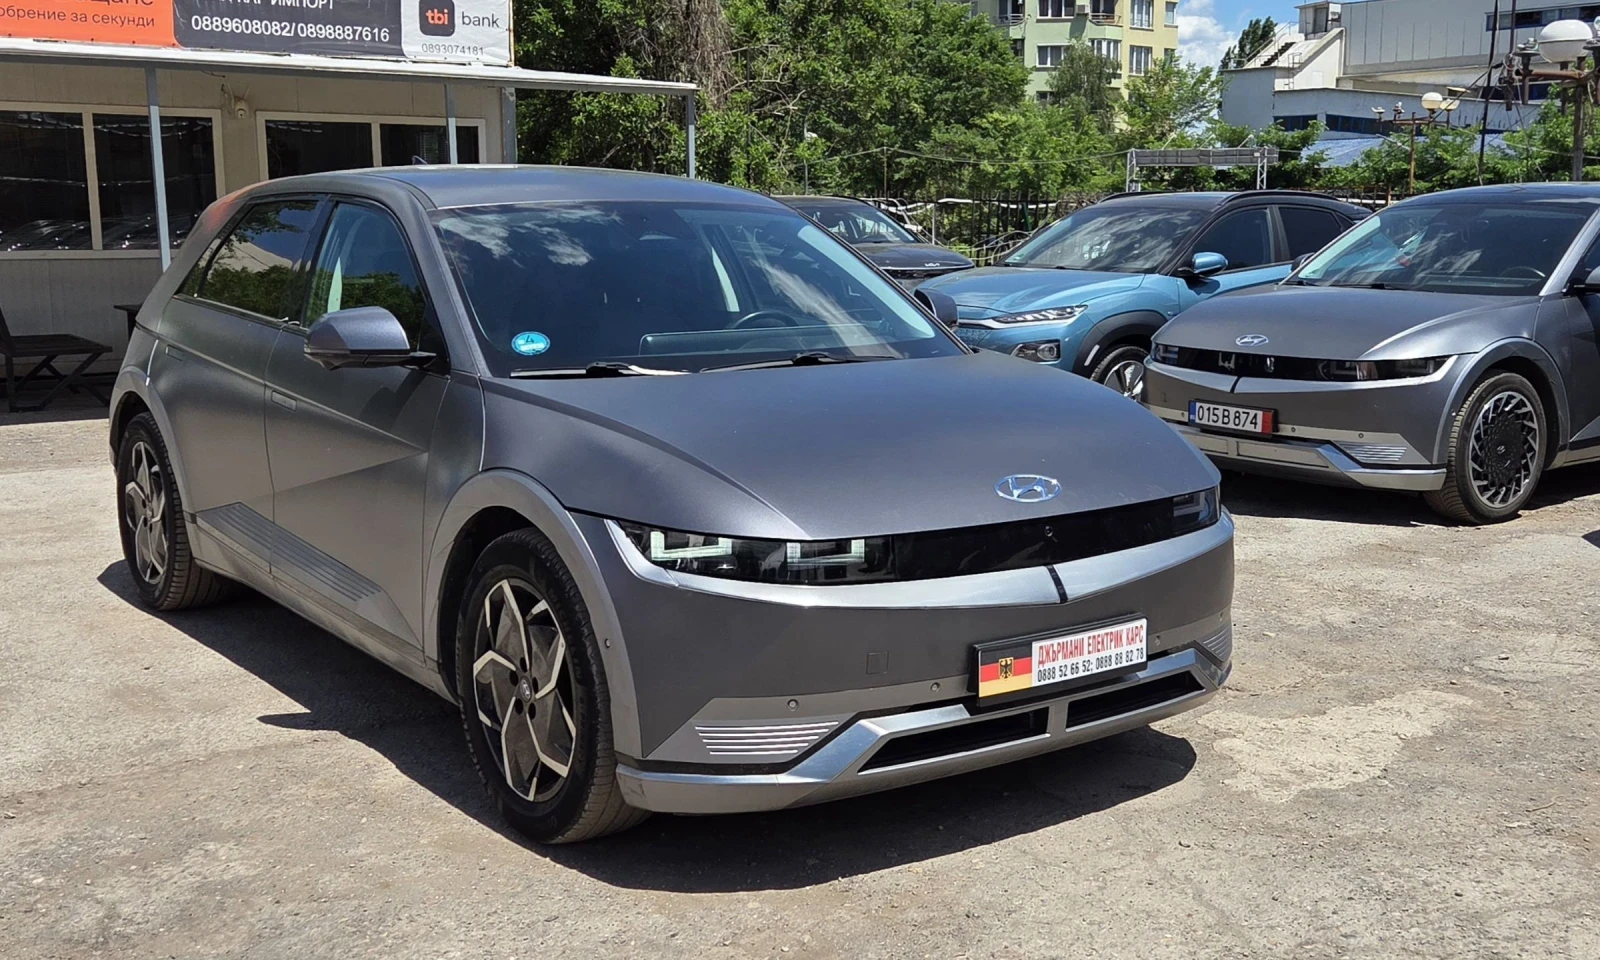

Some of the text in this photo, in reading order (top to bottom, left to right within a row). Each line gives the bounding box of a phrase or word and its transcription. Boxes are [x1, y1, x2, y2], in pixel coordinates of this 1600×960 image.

[70, 12, 88, 23] за
[92, 14, 155, 27] секунди
[426, 9, 500, 28] tbi bank
[421, 43, 484, 56] 0893074181
[1038, 624, 1144, 668] ДЖЪРМАНИ ЕЛЕКТРИК КАРС
[1037, 666, 1057, 683] 0888
[1058, 664, 1068, 678] 52
[1070, 662, 1080, 676] 66
[1095, 654, 1113, 671] 0888
[1114, 652, 1124, 666] 88
[1125, 649, 1134, 663] 82
[1136, 647, 1144, 660] 78
